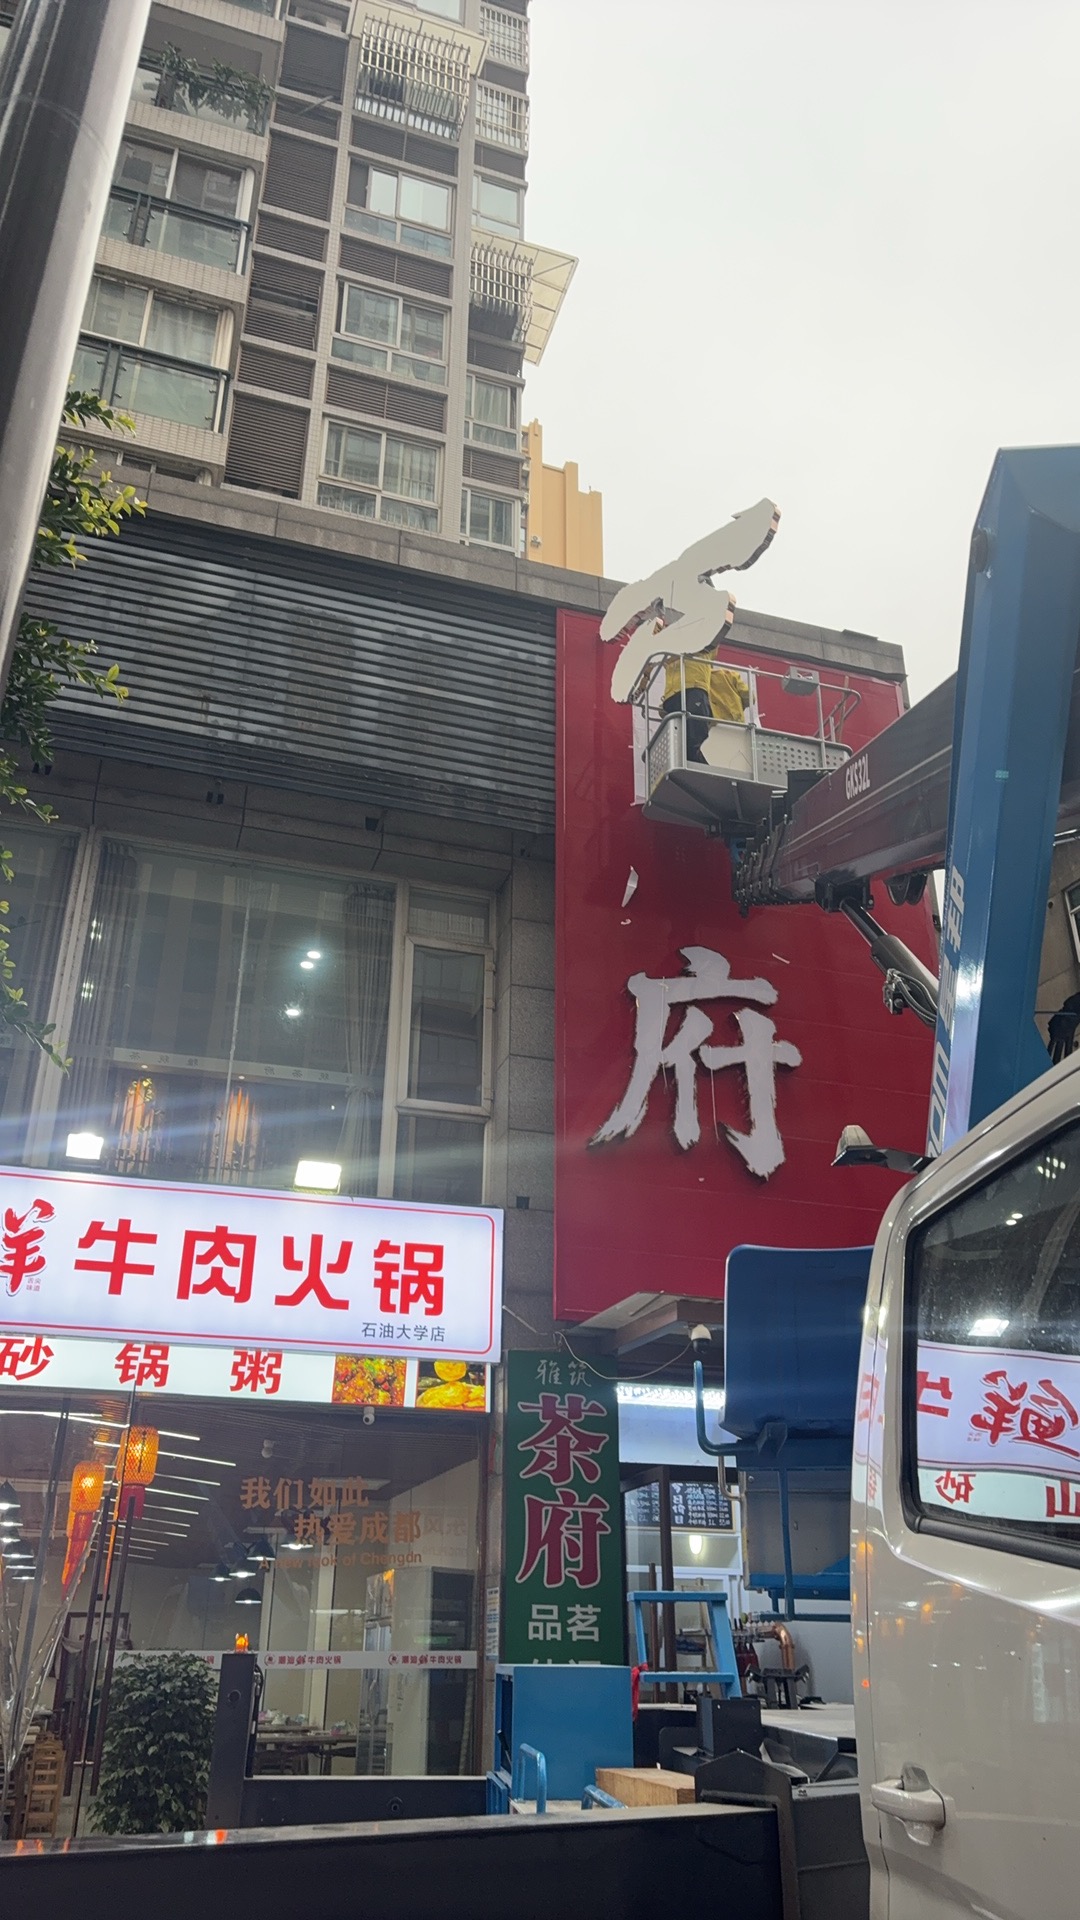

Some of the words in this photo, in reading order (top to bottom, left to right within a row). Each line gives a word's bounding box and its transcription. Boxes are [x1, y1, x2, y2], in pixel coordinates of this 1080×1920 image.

[845, 752, 870, 800] GKS32L
[585, 945, 803, 1183] 府
[361, 1322, 446, 1343] 石油大学店
[0, 1336, 283, 1394] 砂锅粥
[240, 1476, 370, 1511] 我们如此
[515, 1393, 611, 1589] 茶府
[294, 1510, 422, 1545] 热爱成都
[259, 1559, 270, 1570] A
[343, 1553, 356, 1567] of
[528, 1604, 601, 1641] 品茗
